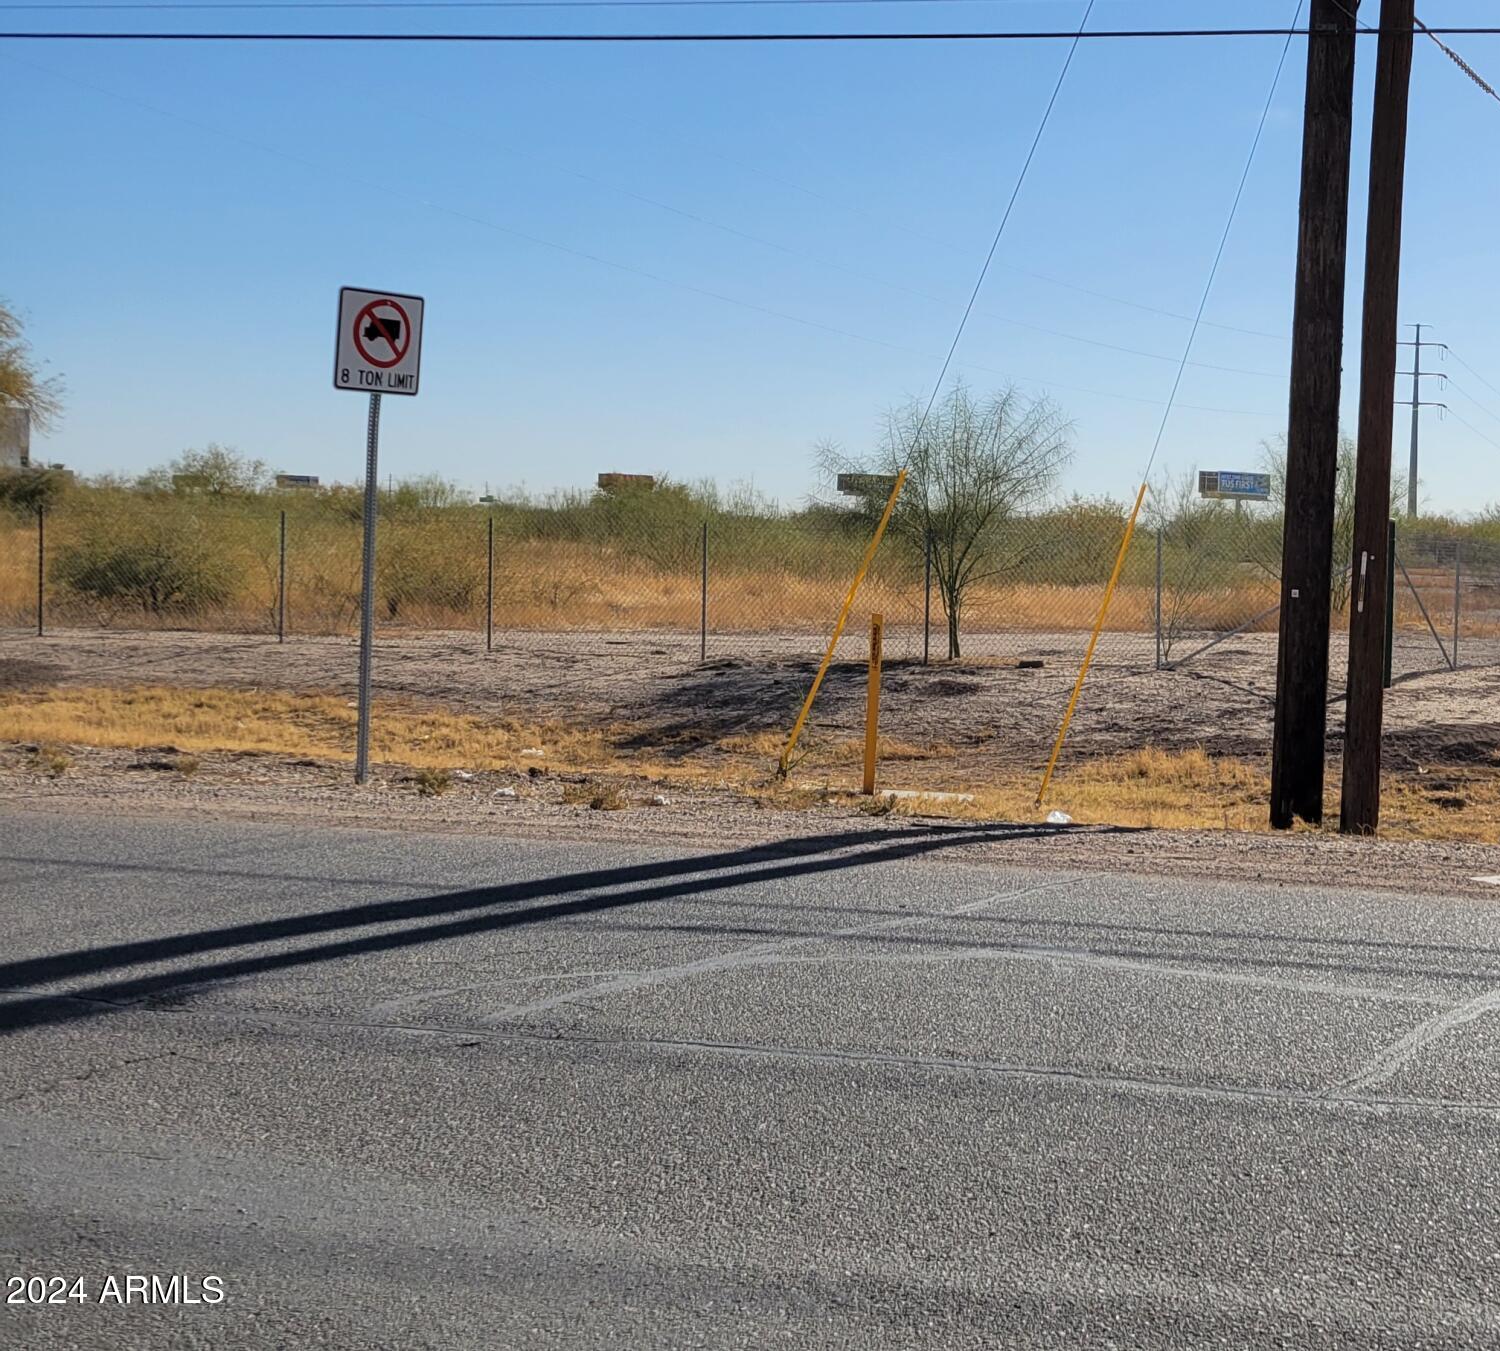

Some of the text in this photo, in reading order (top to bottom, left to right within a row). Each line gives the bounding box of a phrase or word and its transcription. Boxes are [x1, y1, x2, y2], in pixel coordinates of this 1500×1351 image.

[341, 369, 416, 390] 8 TON LIMIT
